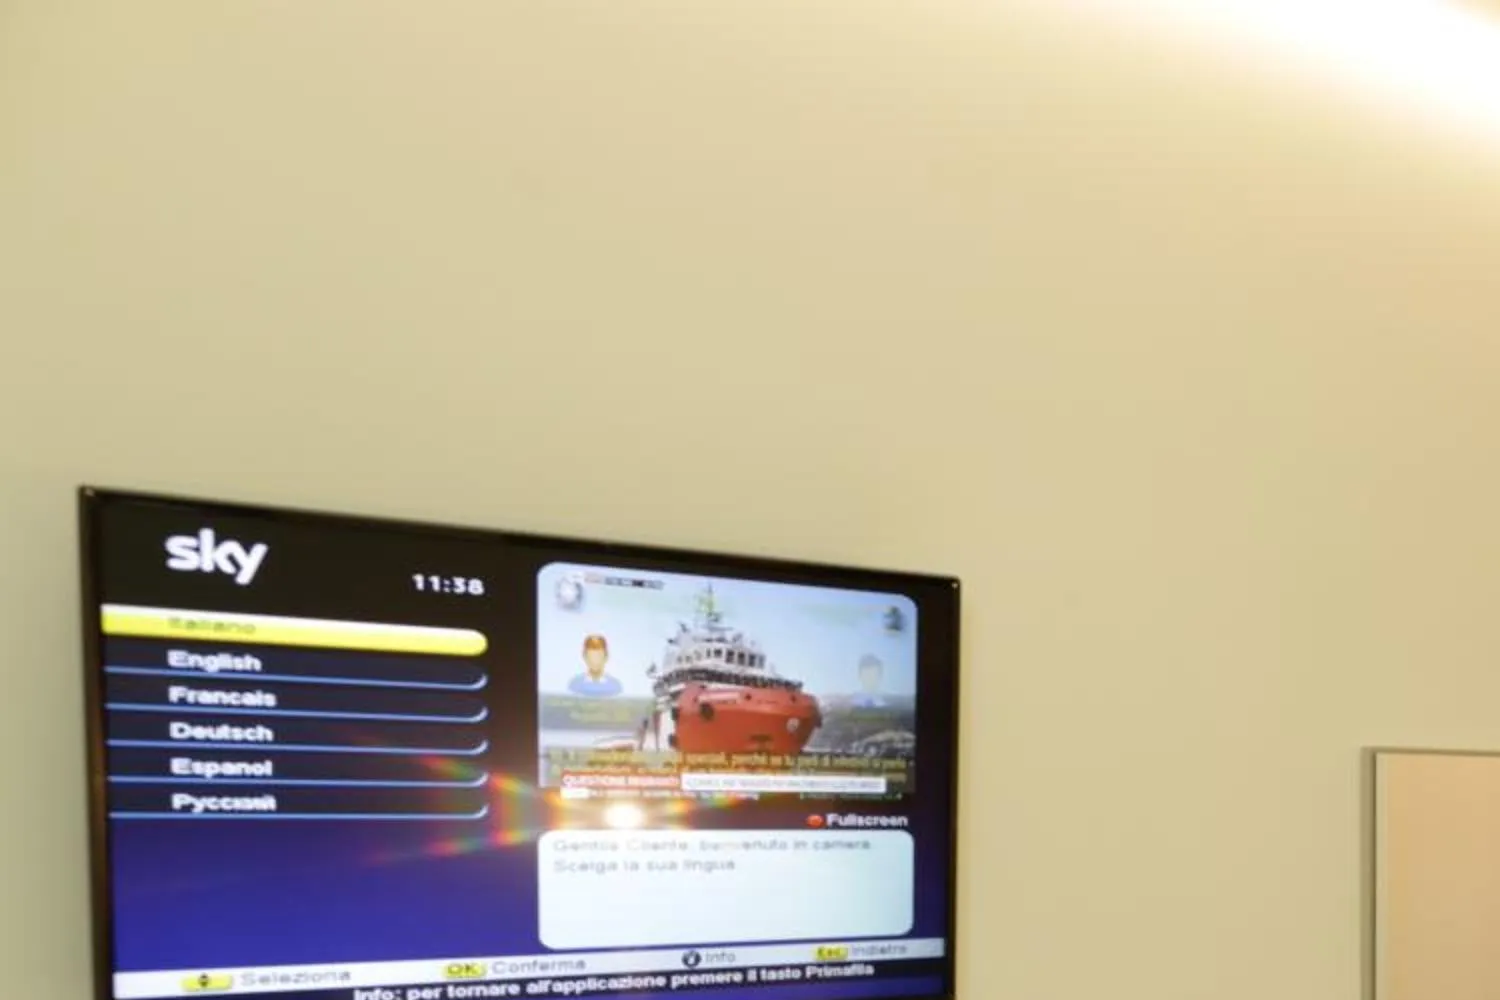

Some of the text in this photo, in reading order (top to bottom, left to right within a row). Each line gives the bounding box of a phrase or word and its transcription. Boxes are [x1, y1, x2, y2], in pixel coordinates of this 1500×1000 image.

[165, 527, 269, 585] sky
[411, 573, 486, 596] 11:38
[166, 649, 263, 672] English
[168, 686, 277, 708] Francais
[169, 721, 275, 742] Deutsch
[170, 757, 274, 778] Espanol
[171, 793, 277, 812] Русский
[826, 812, 909, 828] Fullscreen
[623, 859, 640, 872] la
[647, 861, 678, 872] sua
[705, 952, 736, 964] Info
[852, 943, 908, 957] Indietro
[446, 963, 482, 978] OK
[491, 958, 587, 975] Conferma
[240, 968, 352, 987] Seleziona
[447, 981, 521, 999] tornare
[526, 973, 666, 996] all'applicazione
[671, 970, 743, 988] premere
[748, 968, 757, 981] il
[760, 965, 802, 981] tasto
[805, 962, 875, 979] Primafila
